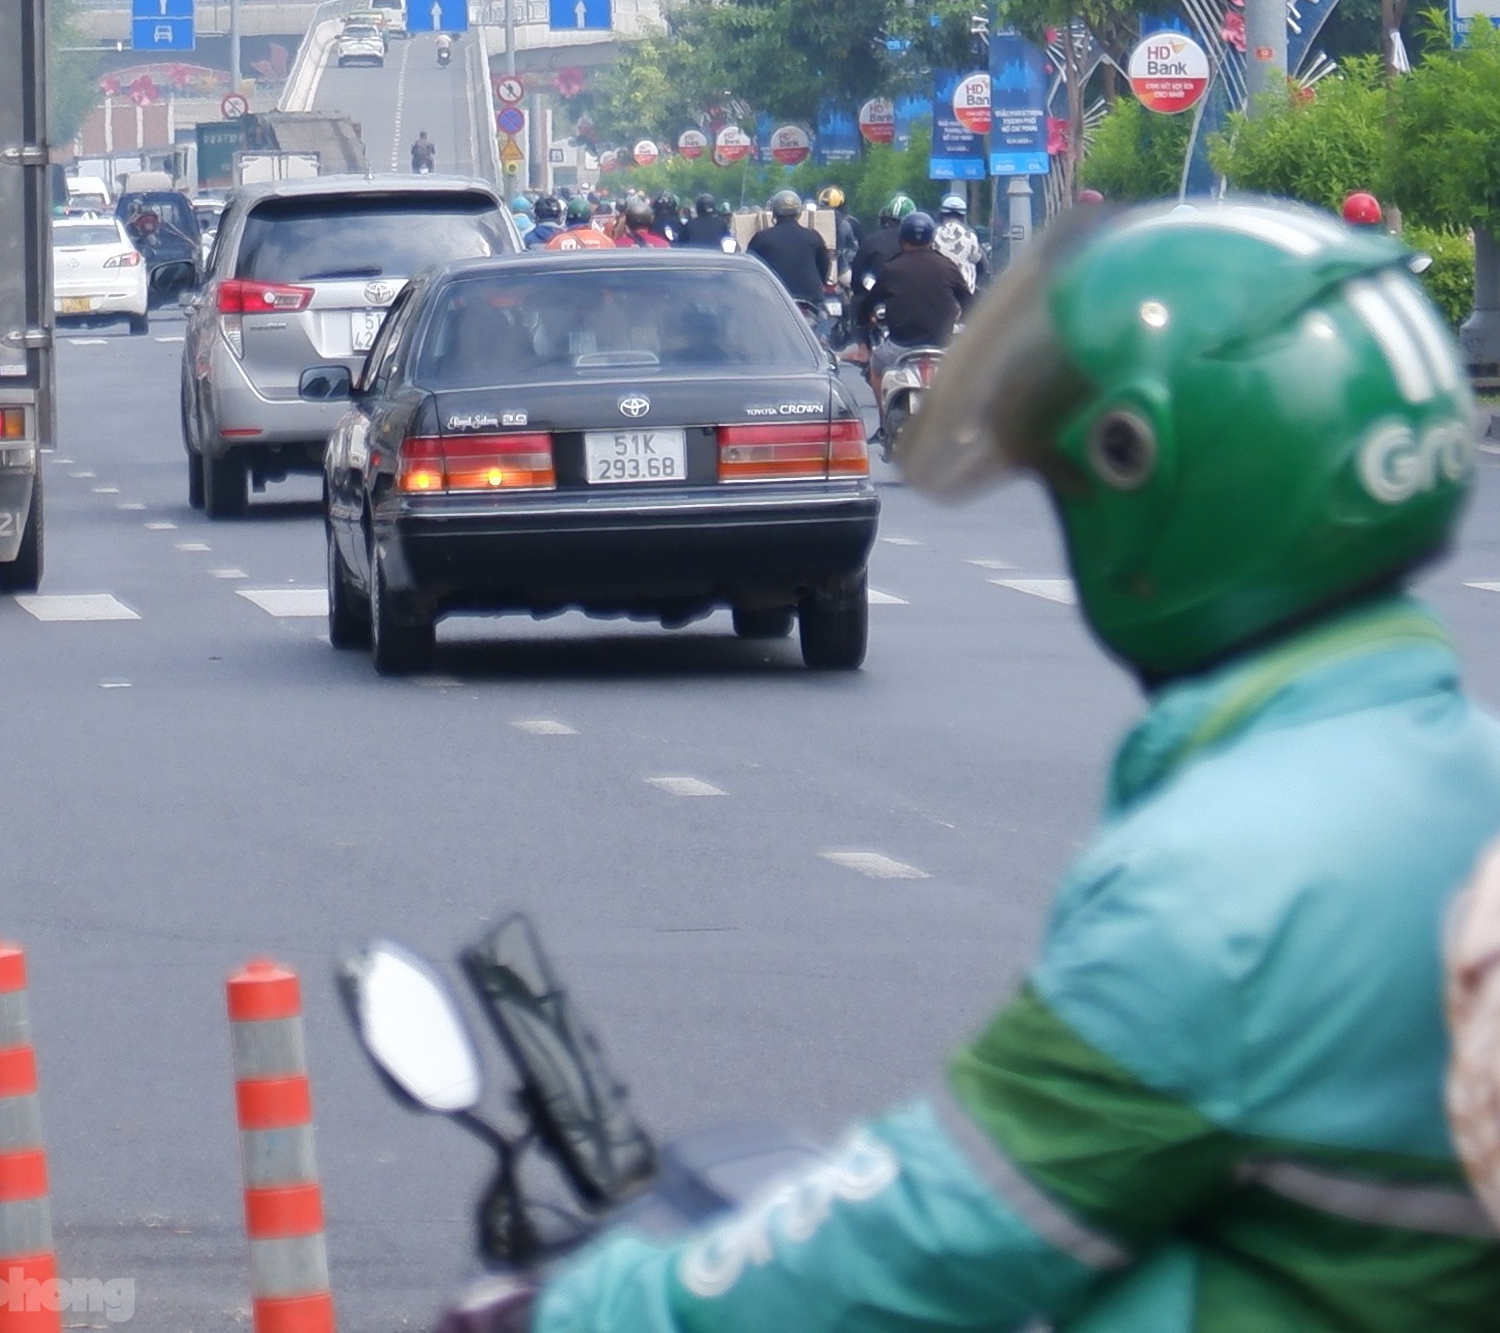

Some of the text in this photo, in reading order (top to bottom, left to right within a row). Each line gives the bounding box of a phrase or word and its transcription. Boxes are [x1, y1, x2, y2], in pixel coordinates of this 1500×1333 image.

[1147, 46, 1171, 60] HD
[1147, 61, 1187, 75] Bank
[965, 84, 984, 95] HD
[966, 95, 991, 106] Ban
[869, 105, 884, 114] HD
[365, 312, 383, 330] 51
[779, 404, 824, 415] CROWN
[614, 434, 656, 456] 51K
[600, 458, 675, 480] 293.68
